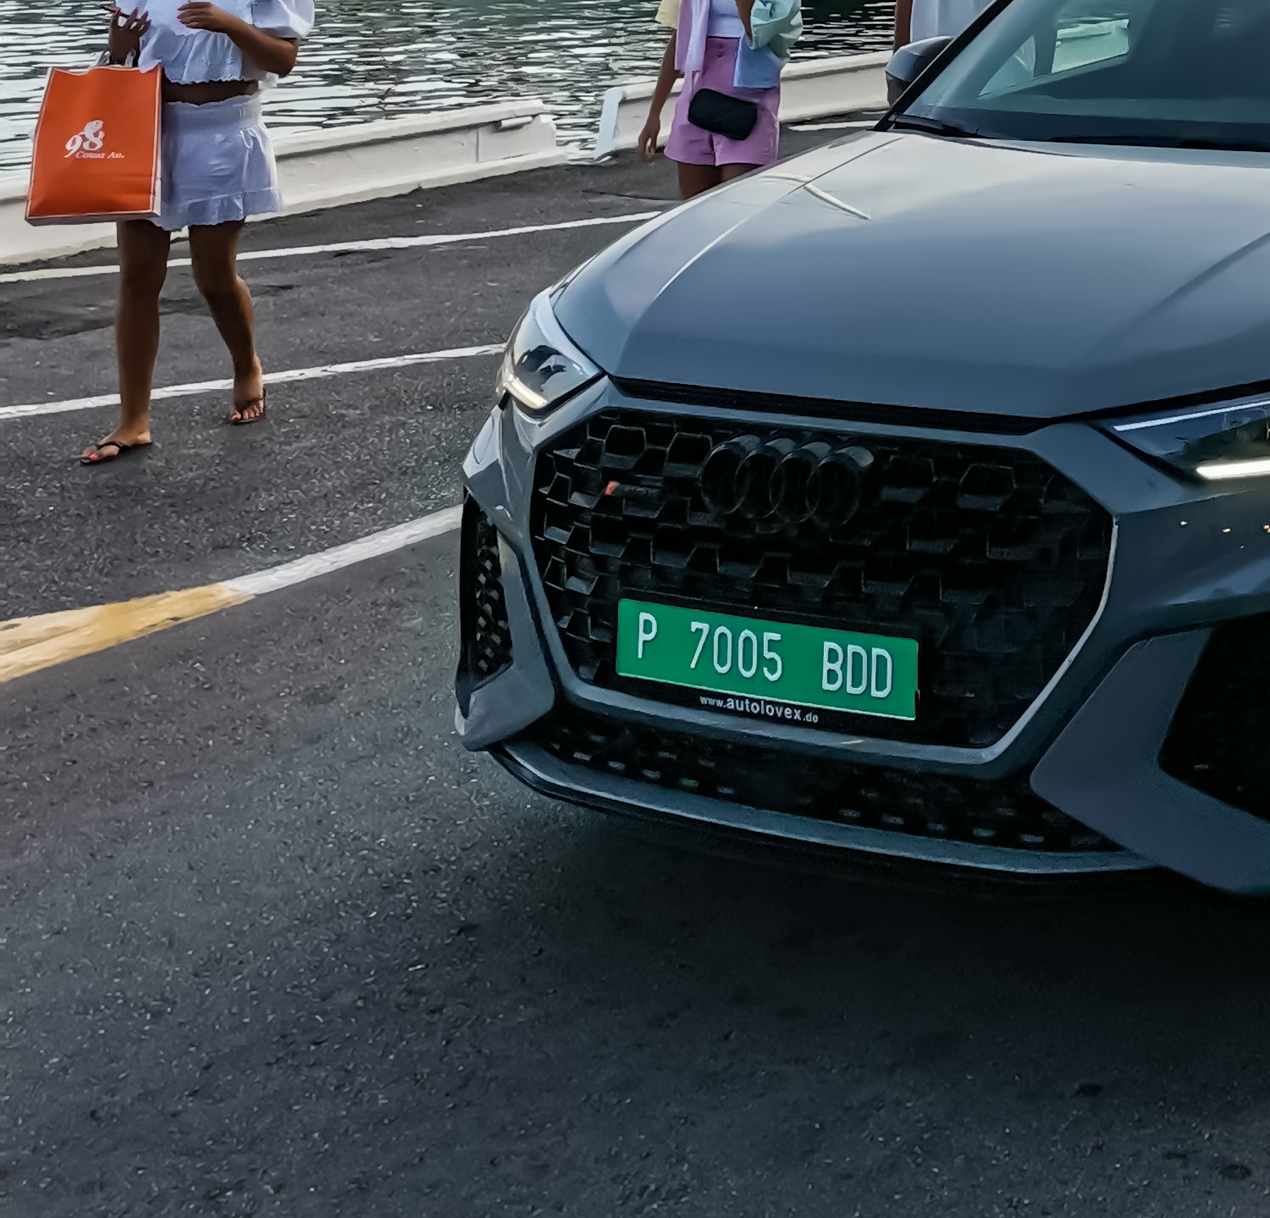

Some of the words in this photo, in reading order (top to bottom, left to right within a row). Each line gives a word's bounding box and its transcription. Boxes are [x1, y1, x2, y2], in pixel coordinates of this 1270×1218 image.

[637, 611, 657, 659] P
[690, 620, 783, 682] 7005
[822, 640, 893, 699] BDD
